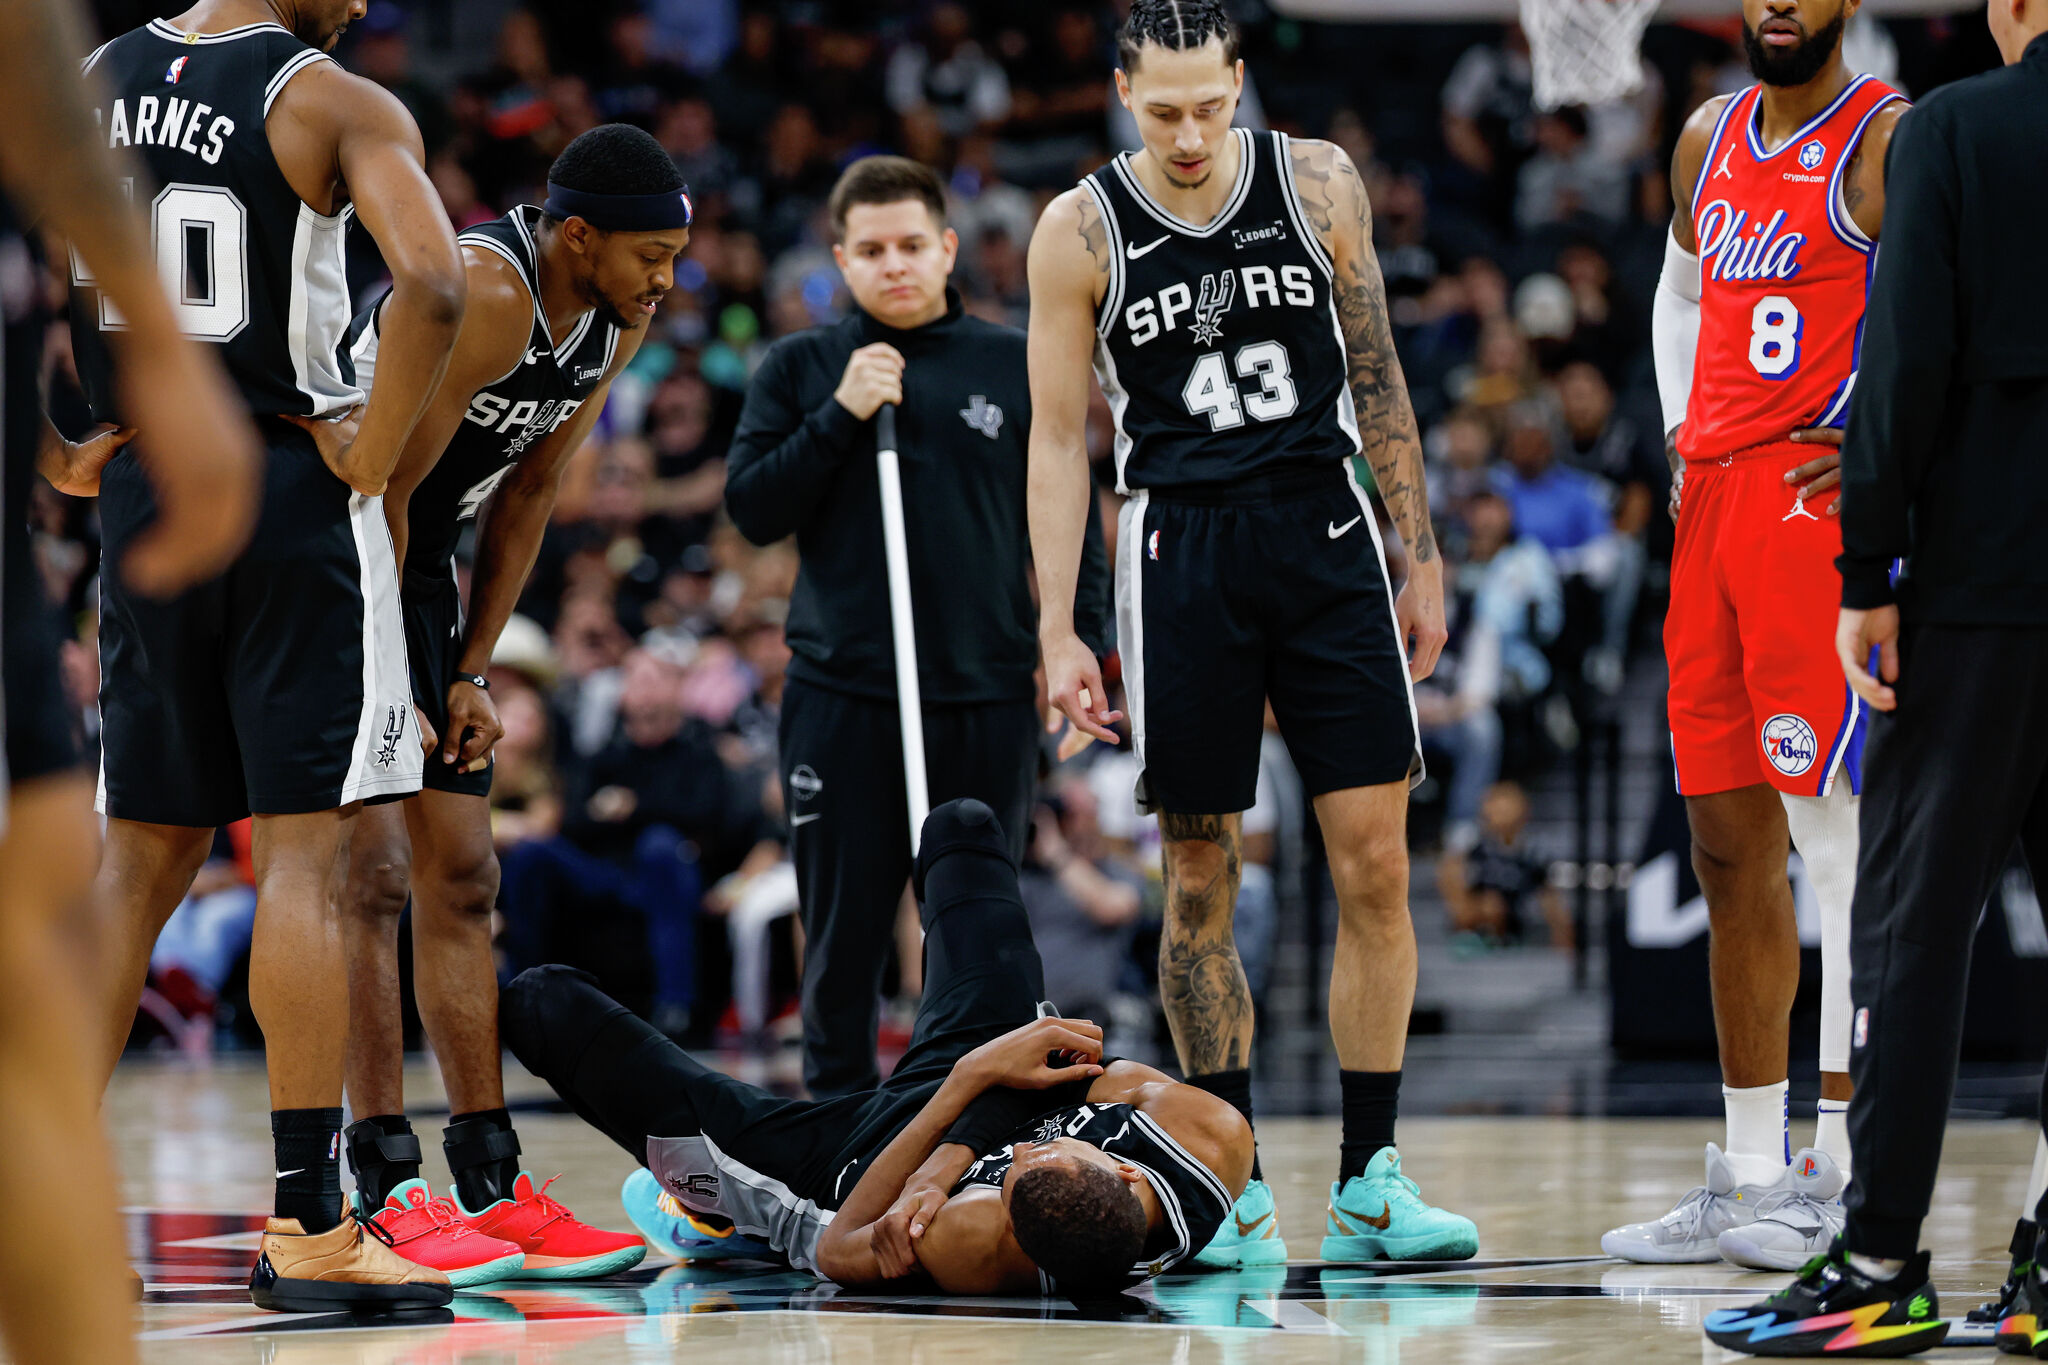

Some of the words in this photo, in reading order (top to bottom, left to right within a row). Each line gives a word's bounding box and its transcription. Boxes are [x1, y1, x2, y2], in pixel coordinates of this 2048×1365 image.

[94, 95, 236, 165] ARNES
[1782, 172, 1826, 183] crypto.com
[1239, 226, 1279, 243] LEDGER
[1697, 199, 1808, 285] Phila
[1125, 265, 1315, 347] SPURS
[1748, 295, 1805, 381] 8
[1181, 340, 1299, 433] 43
[1768, 736, 1812, 760] 76ers
